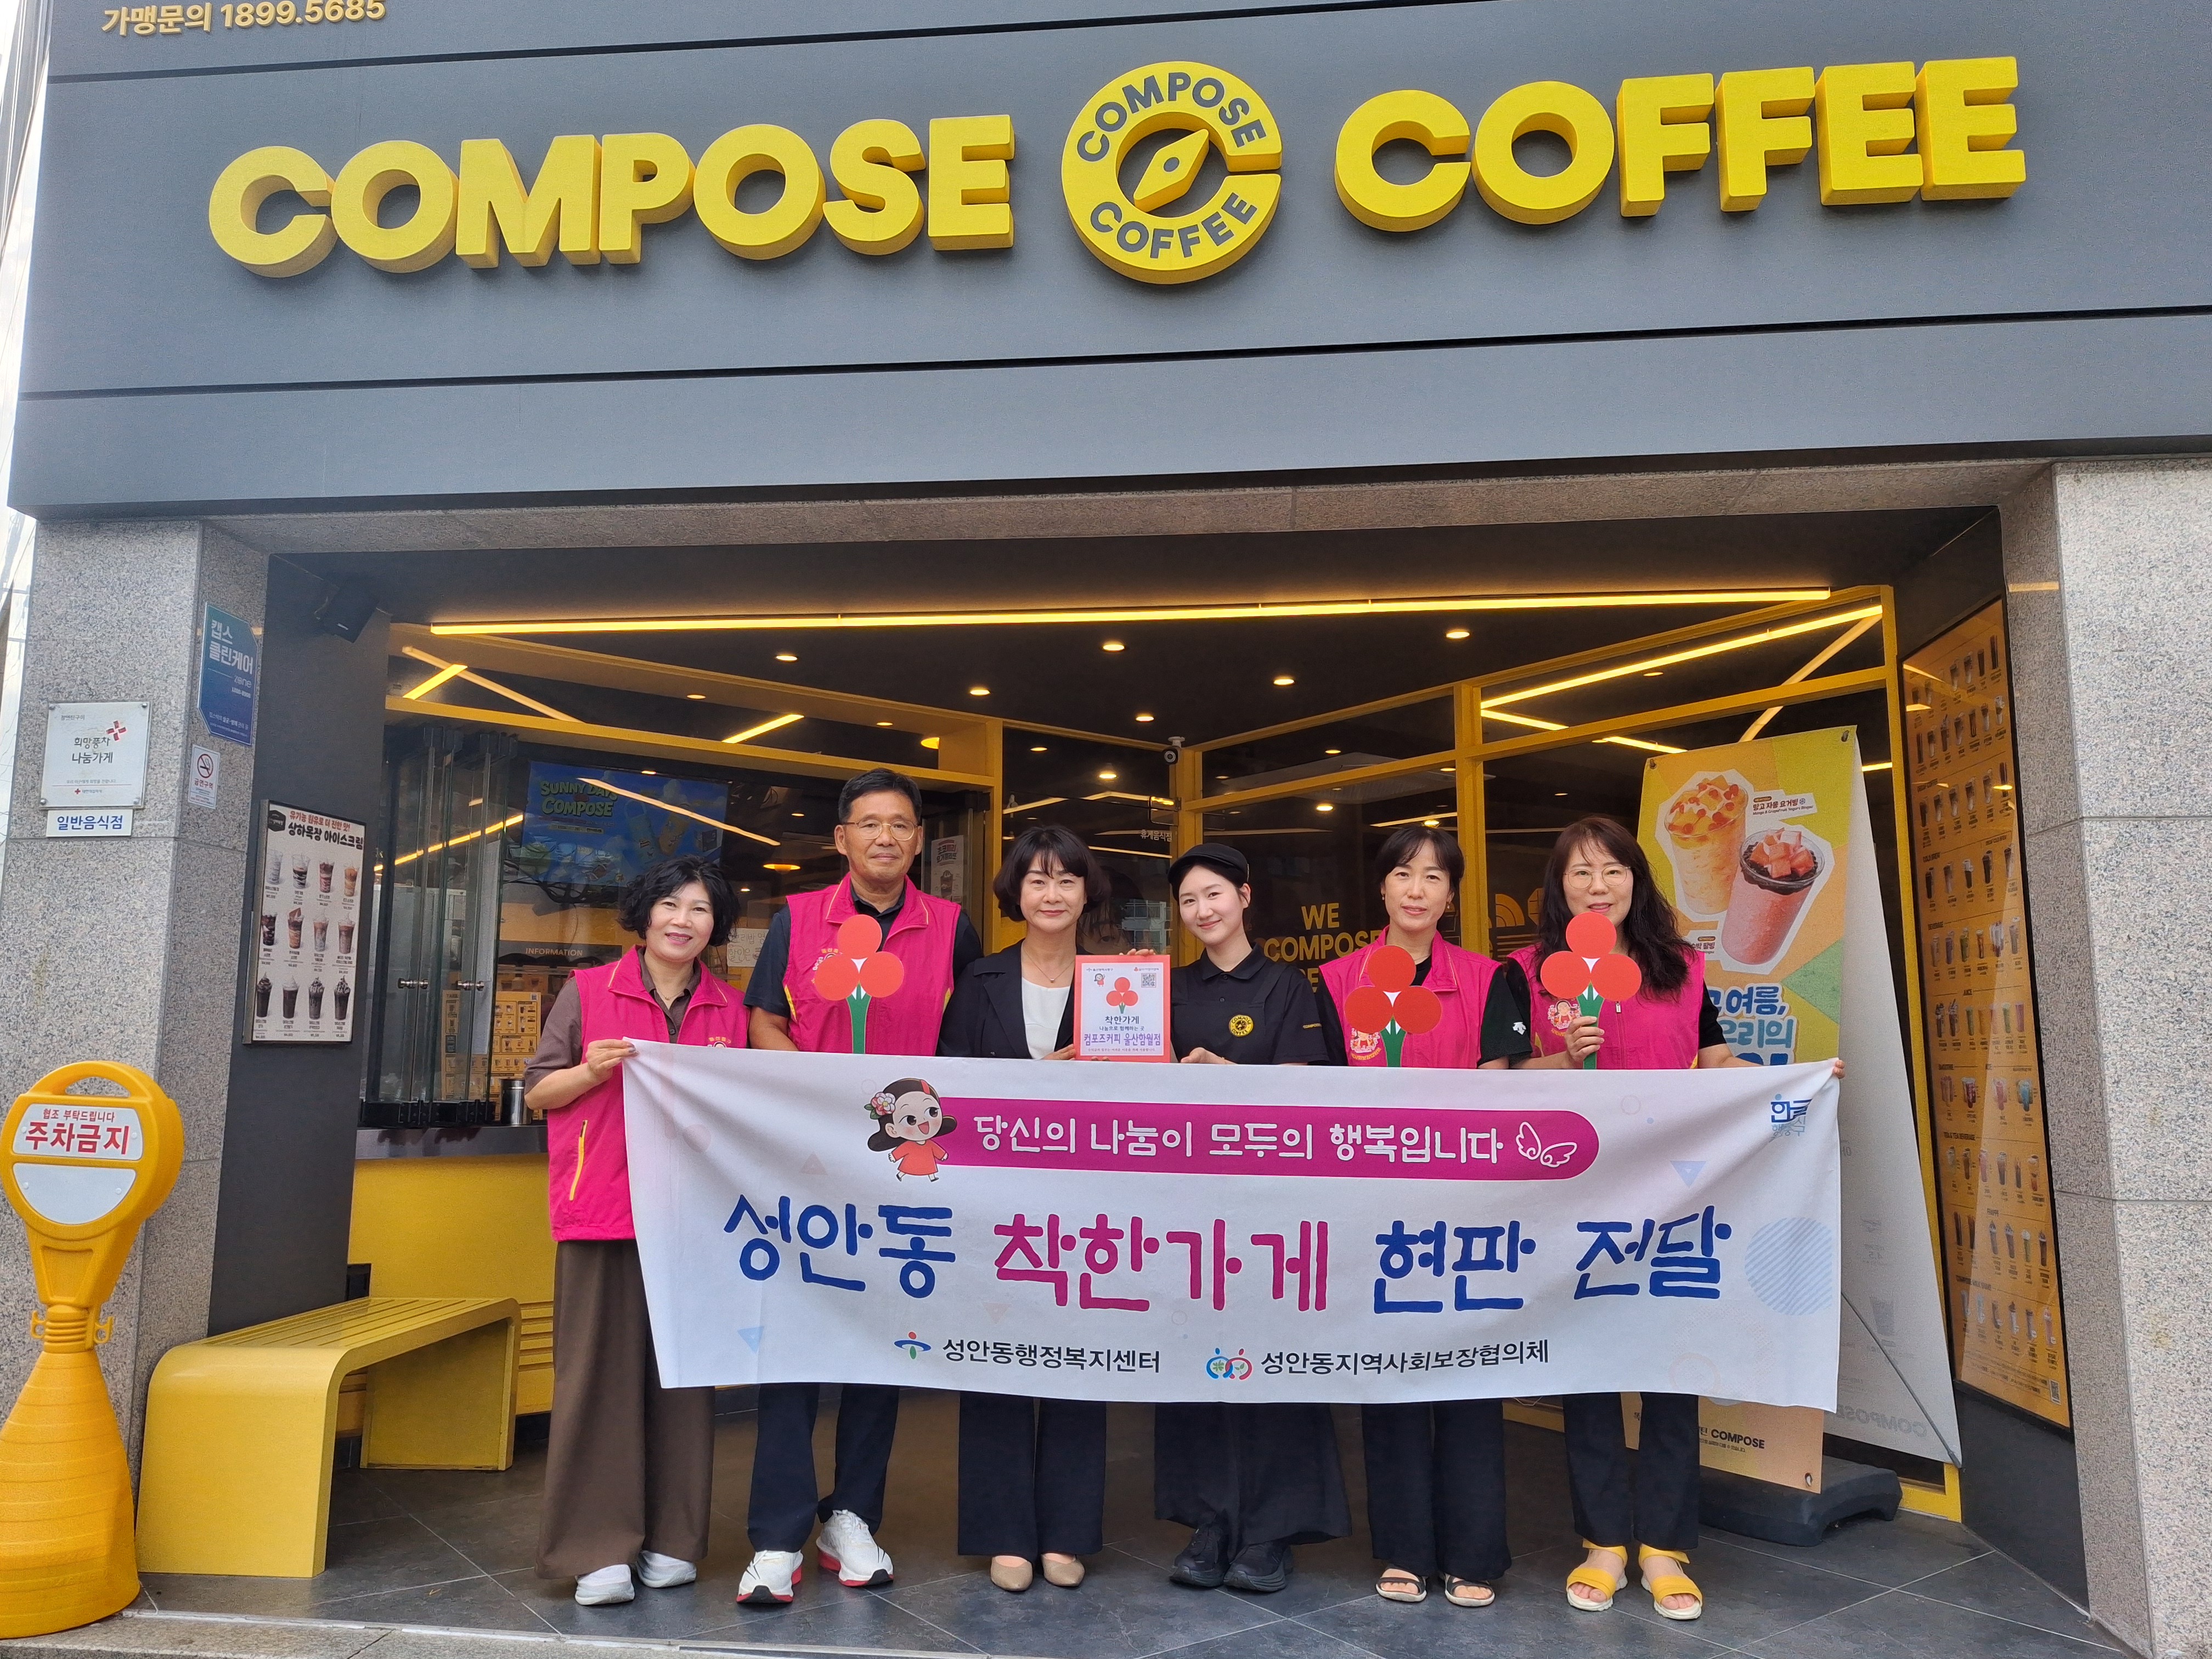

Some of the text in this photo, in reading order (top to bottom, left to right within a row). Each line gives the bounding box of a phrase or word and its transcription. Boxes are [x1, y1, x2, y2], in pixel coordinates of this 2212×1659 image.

[102, 0, 387, 37] 가맹문의 1899.5685
[1077, 72, 1266, 162] COMPOSE
[1334, 56, 2027, 233] COFFEE
[208, 114, 1015, 277] COMPOSE
[1090, 192, 1257, 259] COFFEE
[211, 619, 233, 645] 캡스
[209, 640, 253, 675] 클린케어
[74, 737, 110, 749] 희망풍차
[72, 752, 113, 764] 나눔가게
[195, 778, 213, 790] 금연구역
[540, 781, 586, 795] SUNNY
[542, 797, 614, 817] COMPOSE
[1767, 801, 1779, 809] 자몽
[1780, 798, 1798, 808] 요거빙
[57, 815, 123, 831] 일반음식점
[290, 810, 307, 822] 유기농
[308, 814, 324, 826] 원유로
[288, 822, 322, 841] 상하목장
[324, 831, 363, 850] 아이스크림
[1141, 830, 1172, 842] 휴게음식점
[1301, 902, 1339, 930] WE
[526, 947, 583, 957] INFORMATION
[1105, 1015, 1139, 1025] 착한가게
[1084, 1032, 1161, 1046] 컴포즈커피 울산함월점
[43, 1108, 115, 1123] 협조 부탁드립니다
[25, 1121, 130, 1155] 주차금지
[973, 1114, 1504, 1165] 당신의 나눔이 모두의 행복입니다
[724, 1195, 1731, 1314] 성안동 착한가게 현판 전달
[943, 1339, 1160, 1374] 성안동행정복지센터
[1261, 1339, 1550, 1376] 성안동지역사회보장협의체
[1711, 1429, 1765, 1449] COMPOSE
